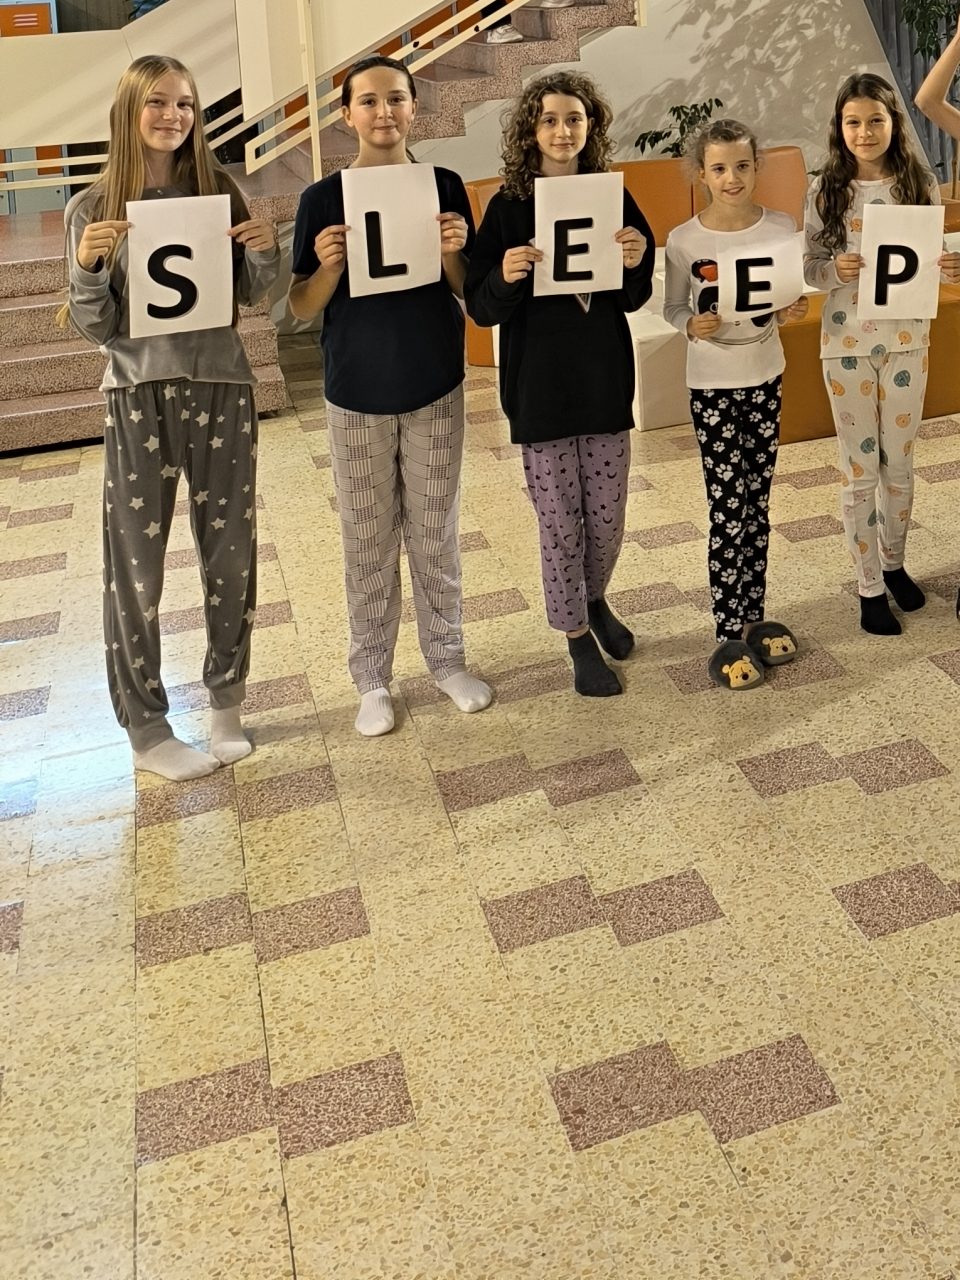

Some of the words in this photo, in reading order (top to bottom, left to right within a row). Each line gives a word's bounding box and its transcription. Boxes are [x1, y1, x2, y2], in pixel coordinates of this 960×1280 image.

[364, 210, 408, 279] L
[552, 217, 594, 282] E
[874, 244, 919, 306] P
[146, 244, 198, 320] S
[734, 256, 774, 313] E
